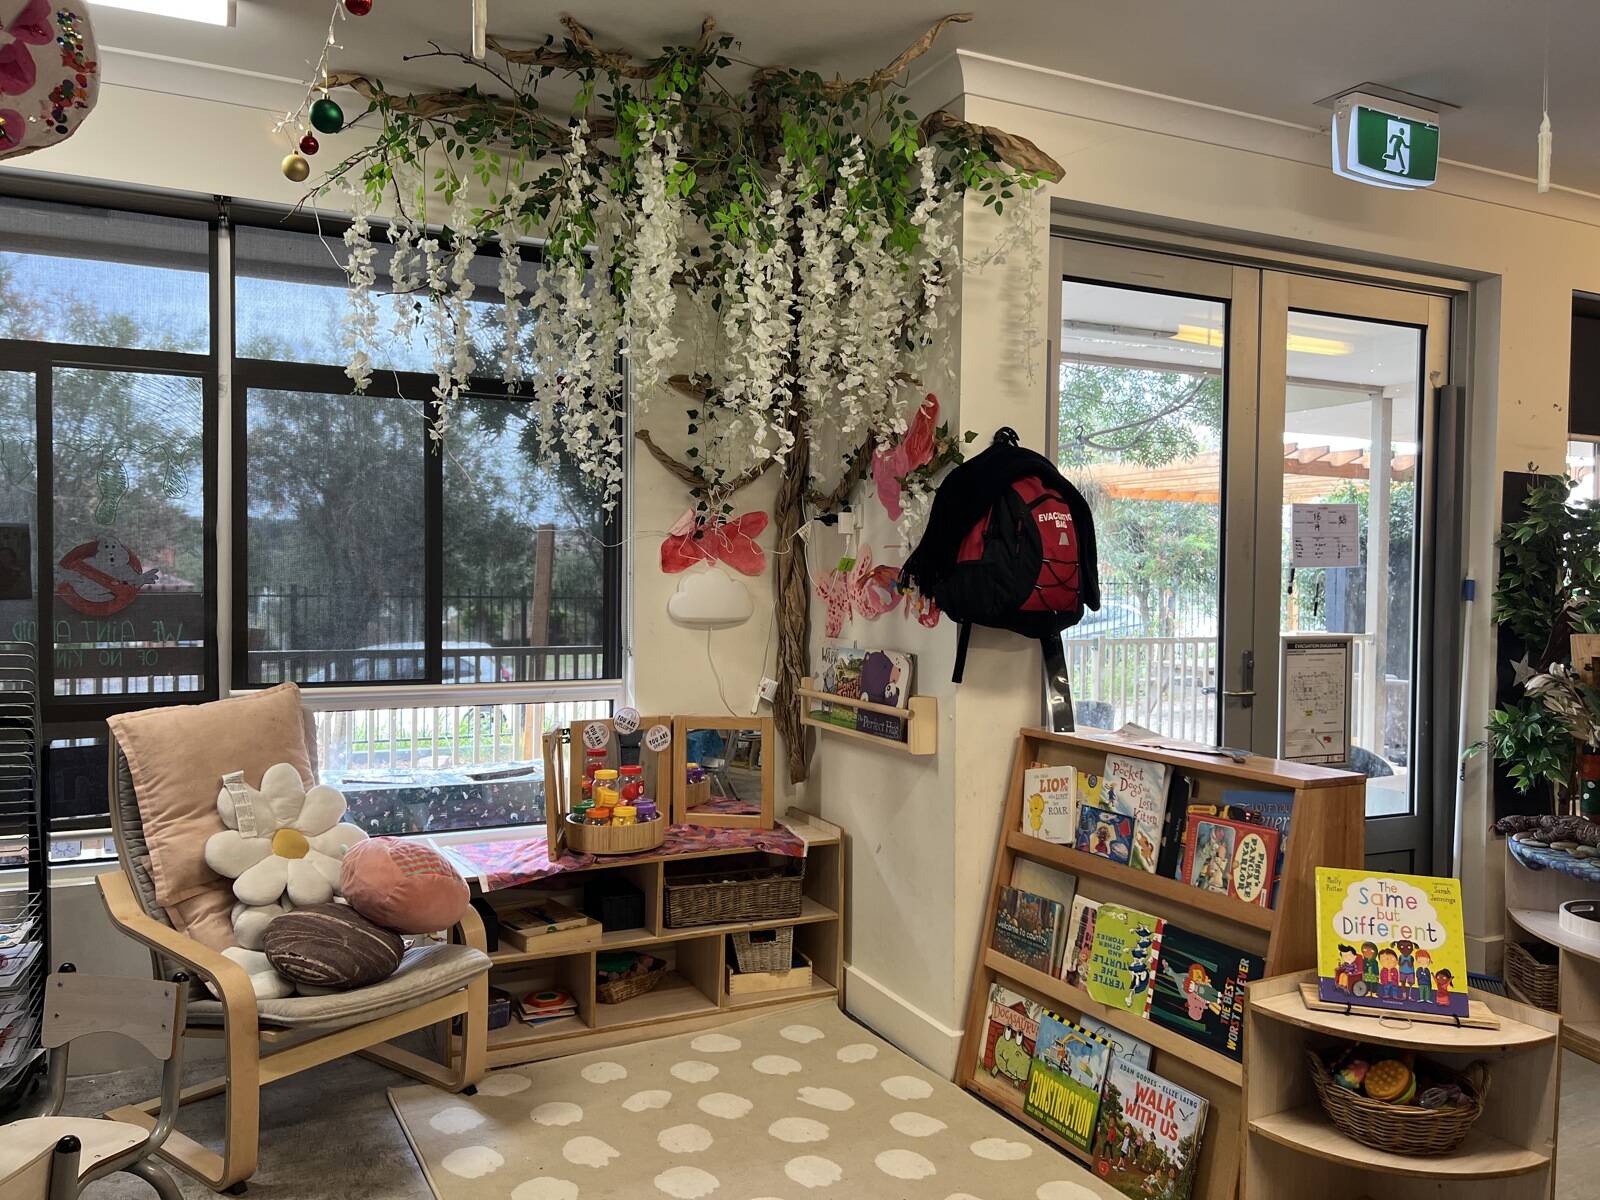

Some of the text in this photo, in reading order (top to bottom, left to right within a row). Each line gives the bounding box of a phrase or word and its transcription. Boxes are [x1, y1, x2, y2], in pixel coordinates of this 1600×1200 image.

[1112, 762, 1144, 781] Pocket
[1040, 777, 1069, 793] LION
[1120, 777, 1143, 797] Dogs
[1237, 841, 1250, 890] PARLOR
[1244, 838, 1258, 898] PANCAKE
[1359, 887, 1417, 910] Same
[1377, 881, 1398, 893] The
[1376, 907, 1400, 922] but
[1342, 916, 1437, 943] Different
[1092, 953, 1128, 971] TURTLE
[1101, 966, 1119, 978] THE
[1092, 973, 1125, 990] YERTLE
[1220, 976, 1235, 1025] THE BEST
[1226, 958, 1250, 1051] WORST DAY EVER
[1120, 1063, 1135, 1075] ADAM
[1136, 1071, 1157, 1088] GOODES
[1029, 1070, 1094, 1139] CONSTRUCTION
[1135, 1081, 1177, 1120] WALK
[1125, 1098, 1179, 1142] WITH US
